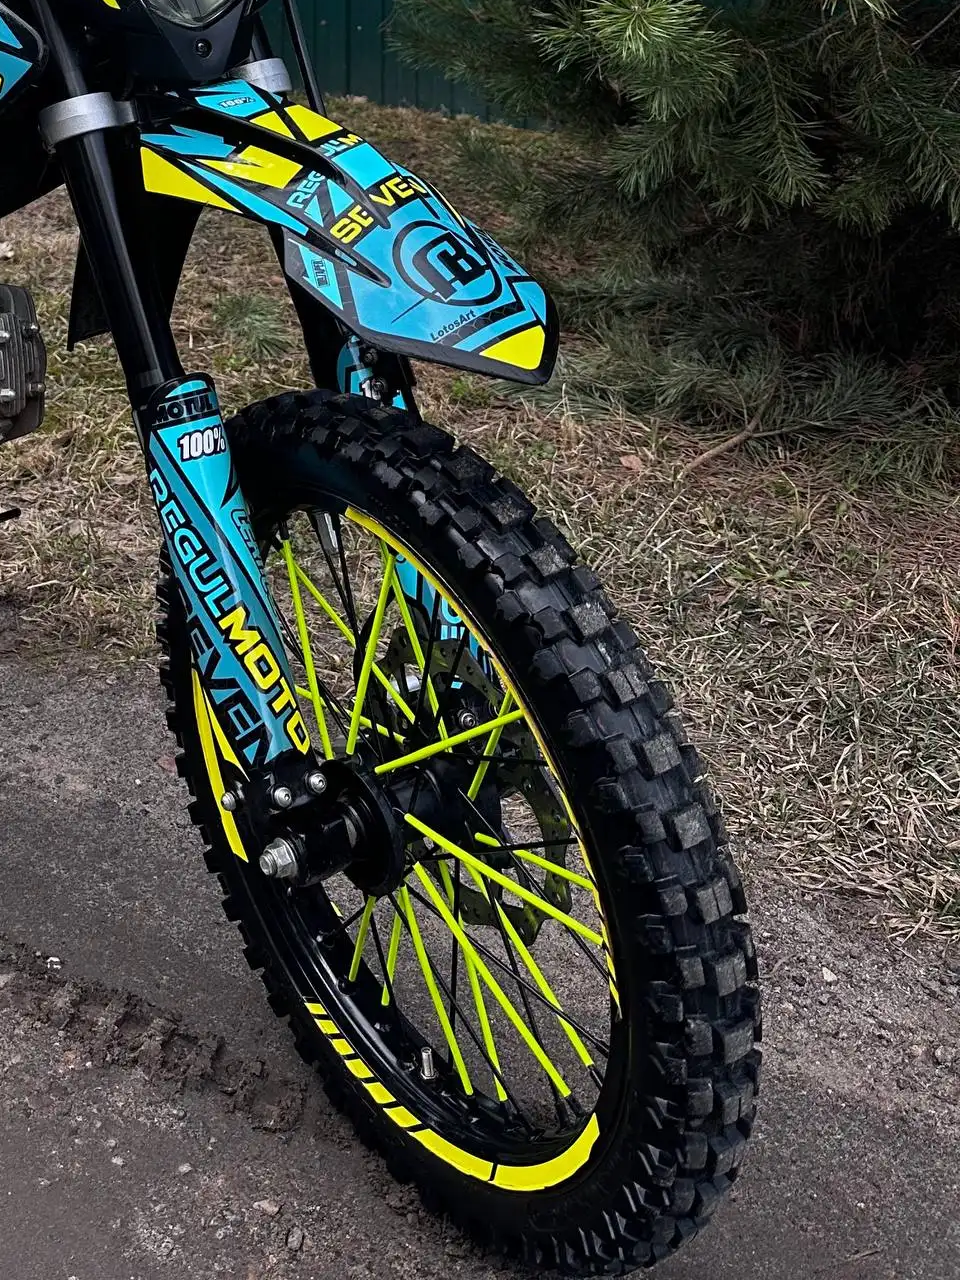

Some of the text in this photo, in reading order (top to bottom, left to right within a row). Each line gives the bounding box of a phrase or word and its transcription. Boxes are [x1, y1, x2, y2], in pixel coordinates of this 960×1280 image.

[218, 96, 256, 109] 100%
[430, 309, 478, 342] LotosArt
[179, 426, 227, 461] 100%
[149, 468, 311, 756] REGULMOTO
[178, 588, 278, 765] EVEN
